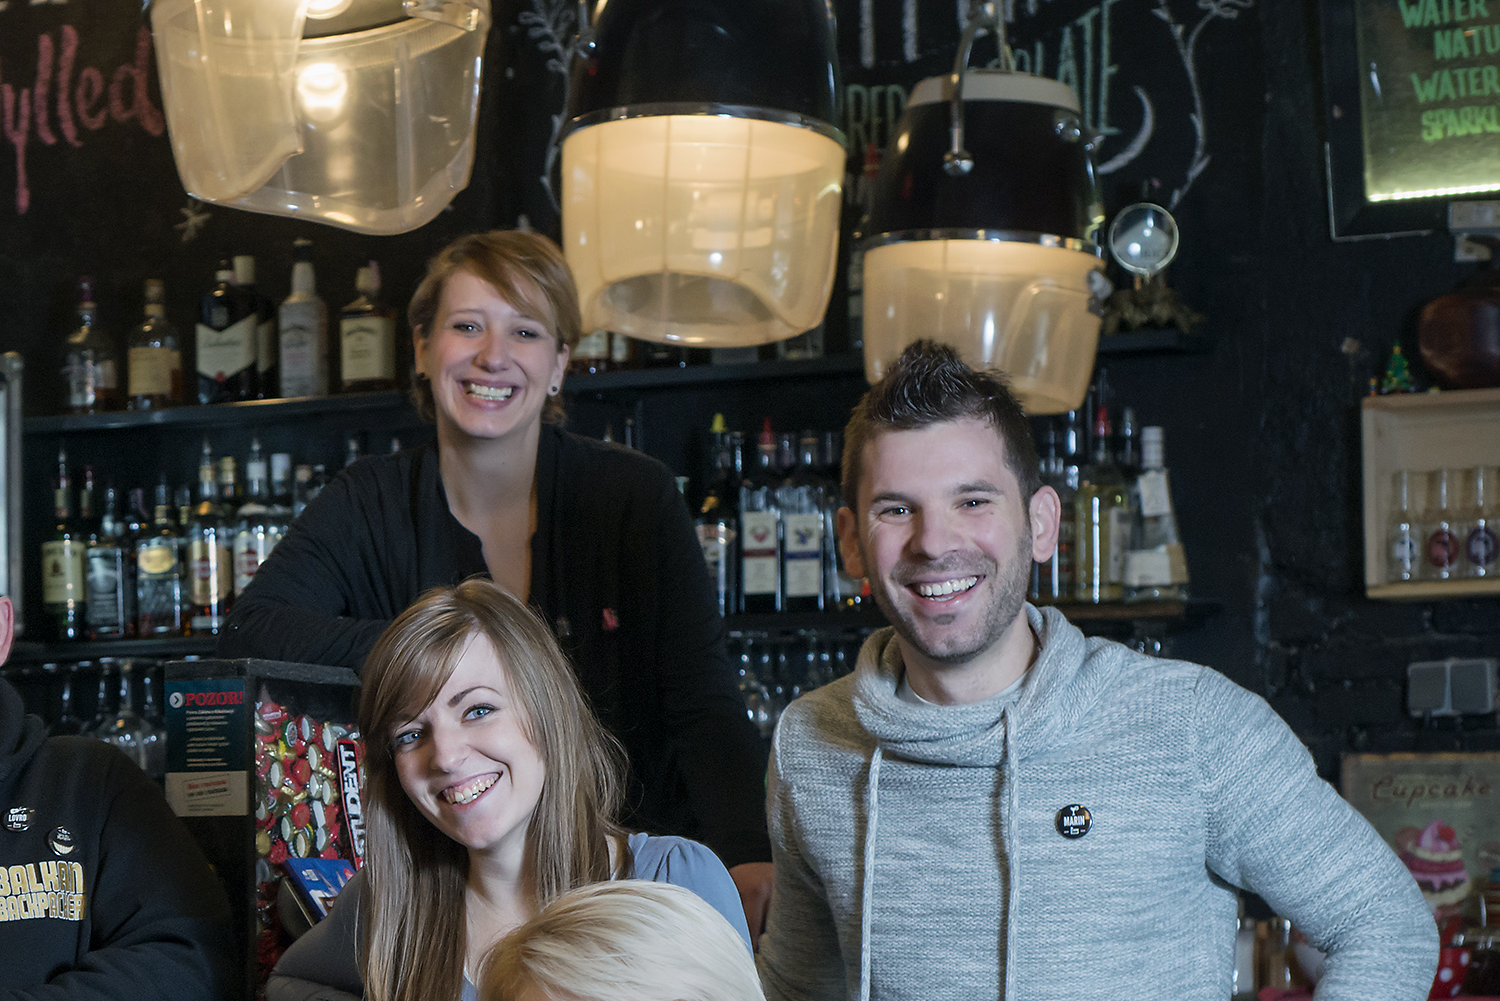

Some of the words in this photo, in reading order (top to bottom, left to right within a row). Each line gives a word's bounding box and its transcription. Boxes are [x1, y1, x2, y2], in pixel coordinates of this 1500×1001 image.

[1410, 65, 1500, 104] WATER
[184, 690, 244, 707] POZOR!
[338, 743, 366, 857] STUDENT
[1371, 774, 1492, 810] Cupcake
